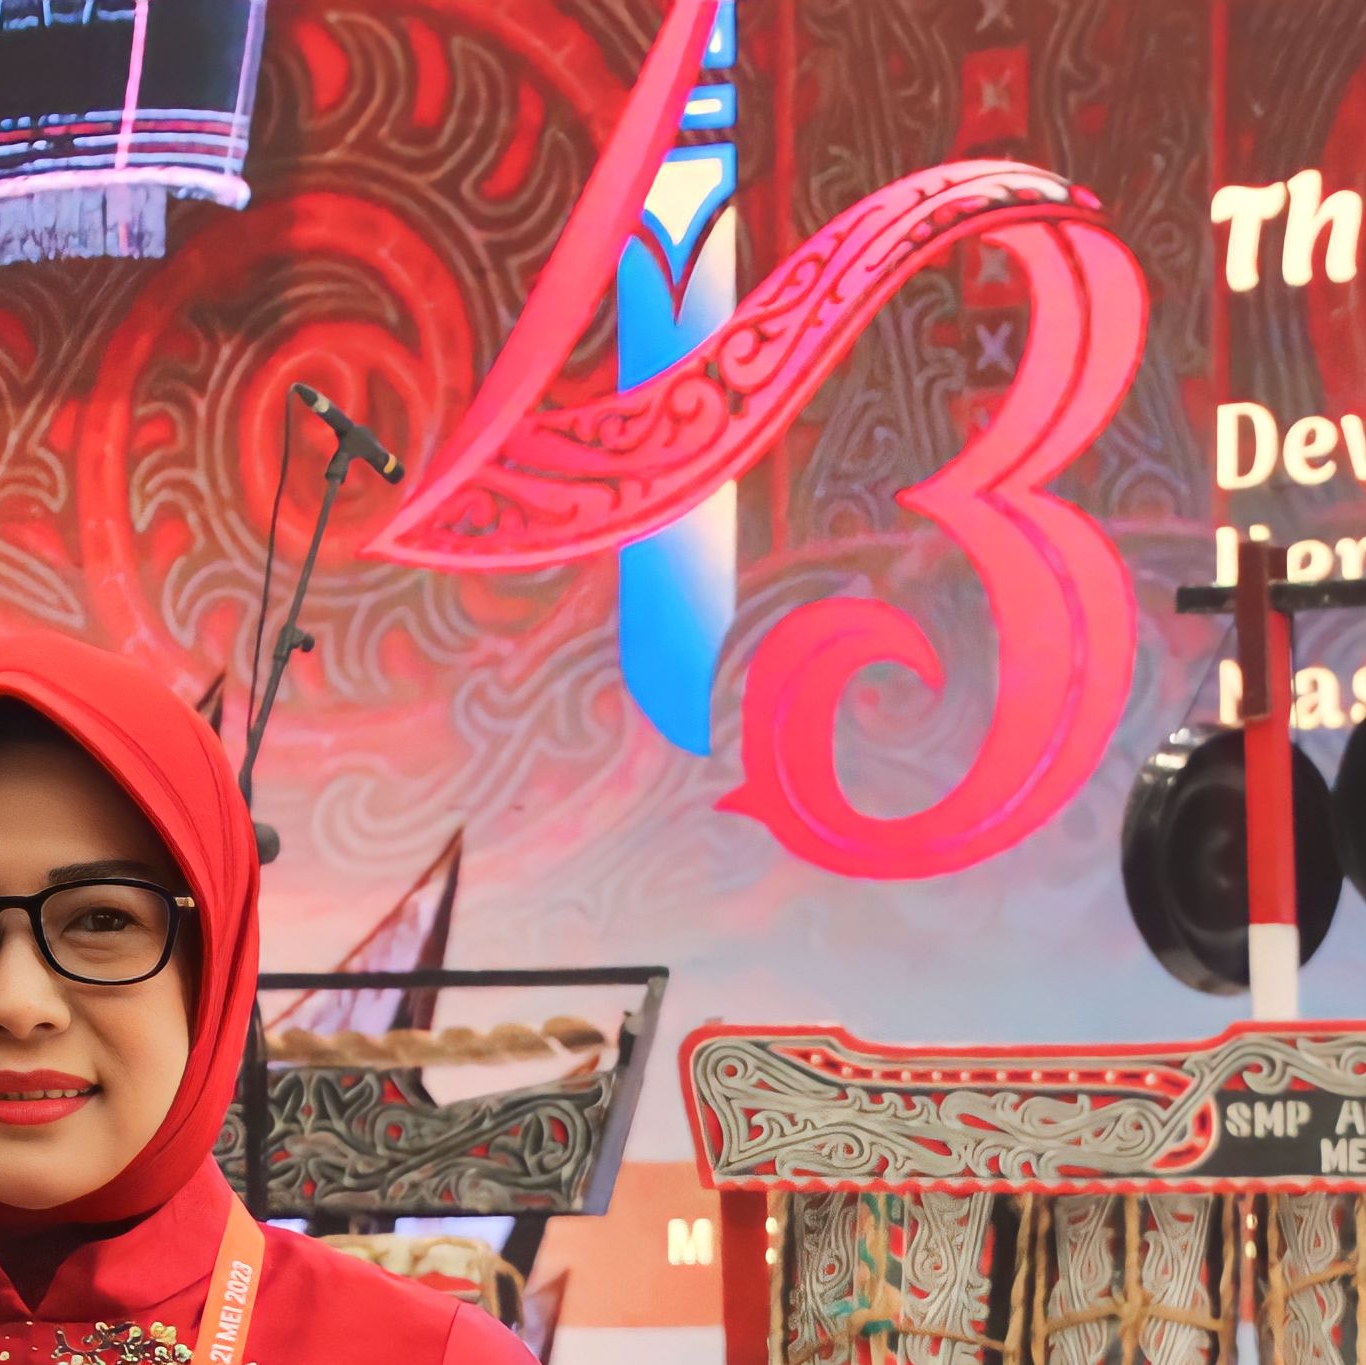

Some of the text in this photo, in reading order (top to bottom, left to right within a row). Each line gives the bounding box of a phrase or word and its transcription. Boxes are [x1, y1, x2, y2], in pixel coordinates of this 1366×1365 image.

[1210, 168, 1363, 292] Th
[1225, 1100, 1312, 1138] SMP
[225, 1260, 253, 1304] 2023
[216, 1305, 244, 1344] MEI
